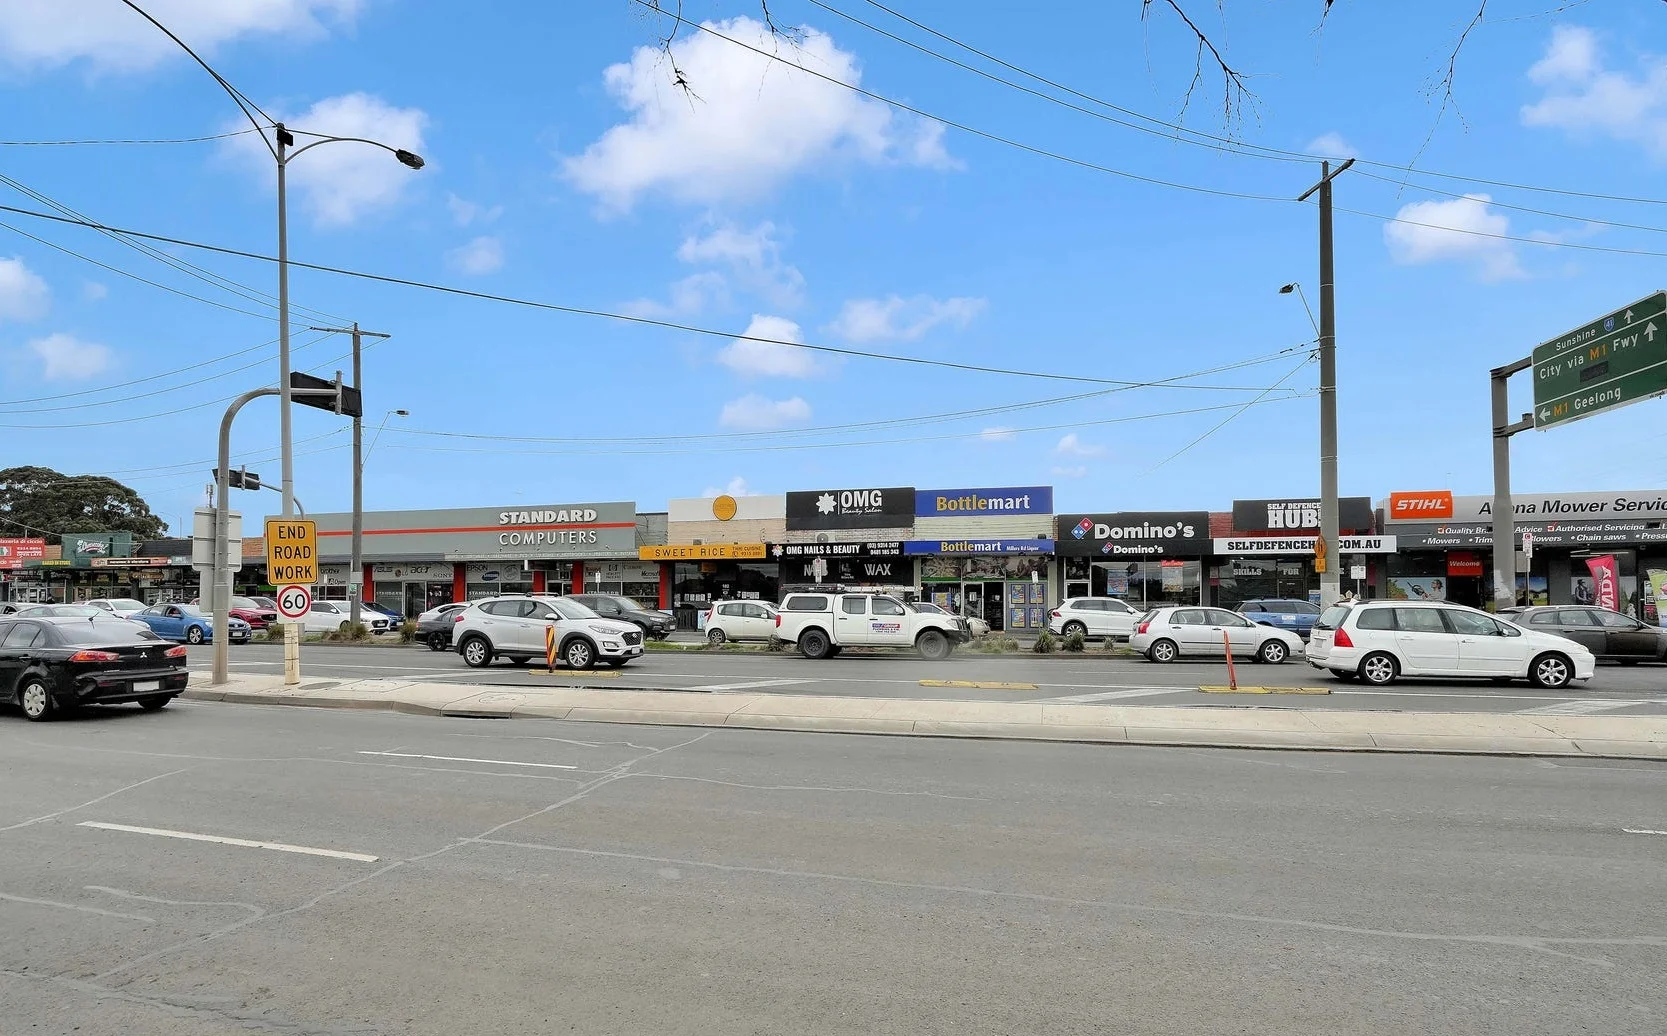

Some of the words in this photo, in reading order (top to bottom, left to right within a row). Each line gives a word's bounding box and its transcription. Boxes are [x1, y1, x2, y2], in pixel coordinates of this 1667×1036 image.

[1556, 328, 1596, 351] Sunshine
[1540, 364, 1561, 379] City
[1567, 355, 1584, 369] via
[1590, 344, 1608, 360] M1
[1613, 333, 1639, 351] Fwy
[1553, 402, 1569, 417] M1
[1574, 387, 1621, 410] Geelong
[840, 490, 882, 507] OMG
[936, 494, 1031, 511] Bottlemart
[1396, 498, 1447, 511] STIHL
[1287, 502, 1321, 510] DEFENCE
[1478, 501, 1536, 515] Ana
[1542, 500, 1608, 513] Mower
[499, 509, 598, 525] STANDARD
[1267, 509, 1318, 528] HUB
[278, 526, 306, 539] END
[1094, 521, 1195, 539] Domino's
[1445, 527, 1474, 535] Quality
[1555, 524, 1602, 532] Authorised
[1604, 523, 1645, 531] Servicing
[499, 530, 597, 546] COMPUTERS
[1427, 537, 1461, 545] Mowers
[1532, 535, 1562, 543] lowers
[1576, 533, 1602, 541] Chain
[1641, 532, 1667, 540] Press
[786, 546, 802, 555] OMG
[804, 545, 824, 554] NAILS
[825, 545, 831, 554] &
[833, 544, 860, 554] BEAUTY
[941, 541, 1002, 552] Bottlemart
[1113, 544, 1164, 554] Domino's
[1227, 539, 1382, 551] SELFDEFENCEHCOM.AU
[274, 545, 311, 560] ROAD
[655, 548, 693, 557] SWEET
[700, 547, 726, 556] RICE
[273, 565, 312, 580] WORK
[410, 566, 431, 574] acer
[466, 564, 488, 572] EPSON
[864, 563, 892, 576] WAX
[1233, 568, 1262, 576] SKILLS
[282, 593, 306, 609] 60
